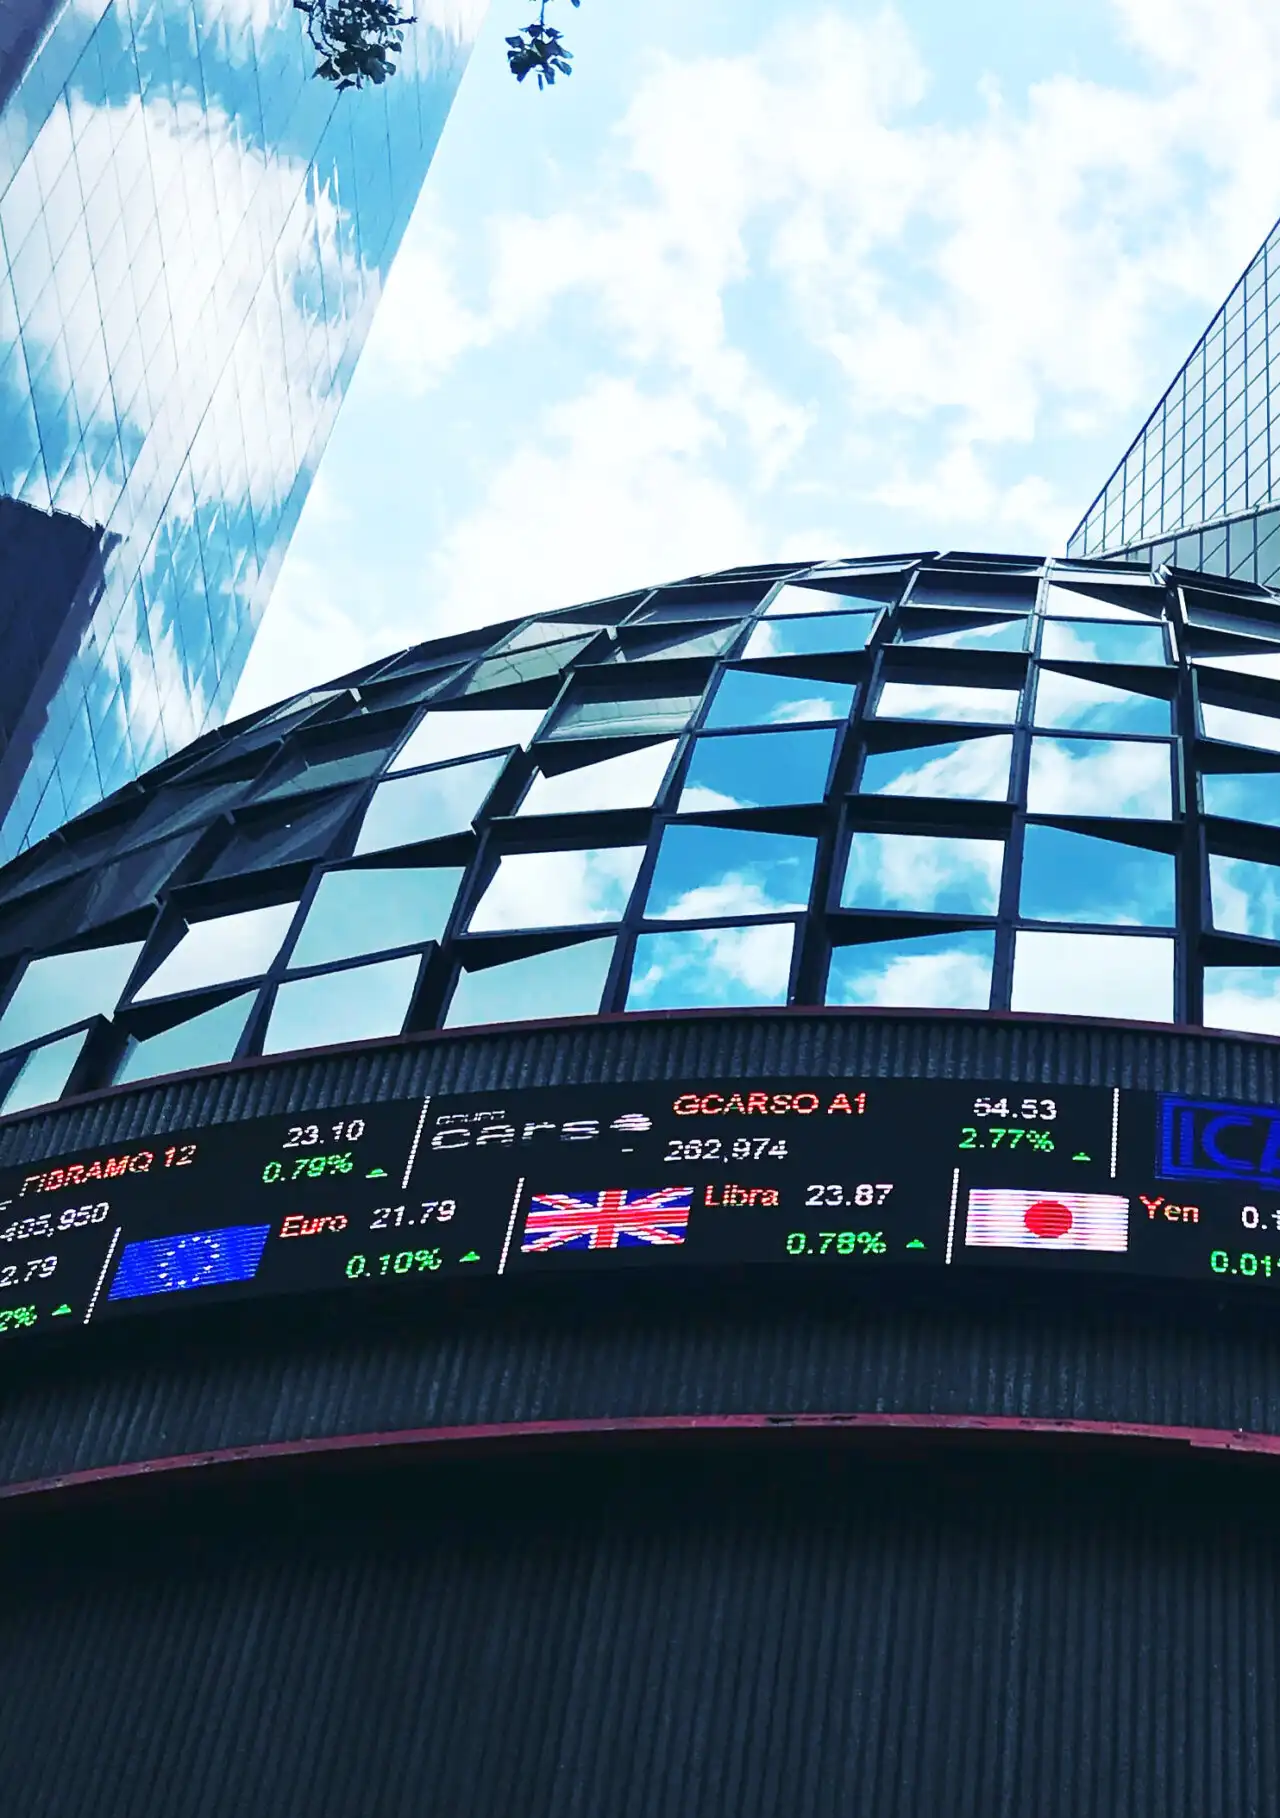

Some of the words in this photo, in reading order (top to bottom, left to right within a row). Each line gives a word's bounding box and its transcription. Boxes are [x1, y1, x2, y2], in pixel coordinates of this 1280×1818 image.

[672, 1092, 820, 1115] GCARSO
[827, 1092, 867, 1114] A1
[973, 1097, 1058, 1121] 54.53
[283, 1119, 365, 1148] 23.10
[958, 1127, 1055, 1152] 2.77%
[165, 1144, 196, 1167] 12
[663, 1137, 789, 1164] 262,974
[262, 1152, 353, 1184] 0.79%
[704, 1184, 780, 1208] Libra
[805, 1183, 893, 1207] 23.87
[278, 1213, 348, 1239] Euro
[369, 1199, 456, 1231] 21.79
[1139, 1195, 1200, 1223] Yen
[786, 1231, 887, 1255] 0.78%
[345, 1249, 442, 1280] 0.10%
